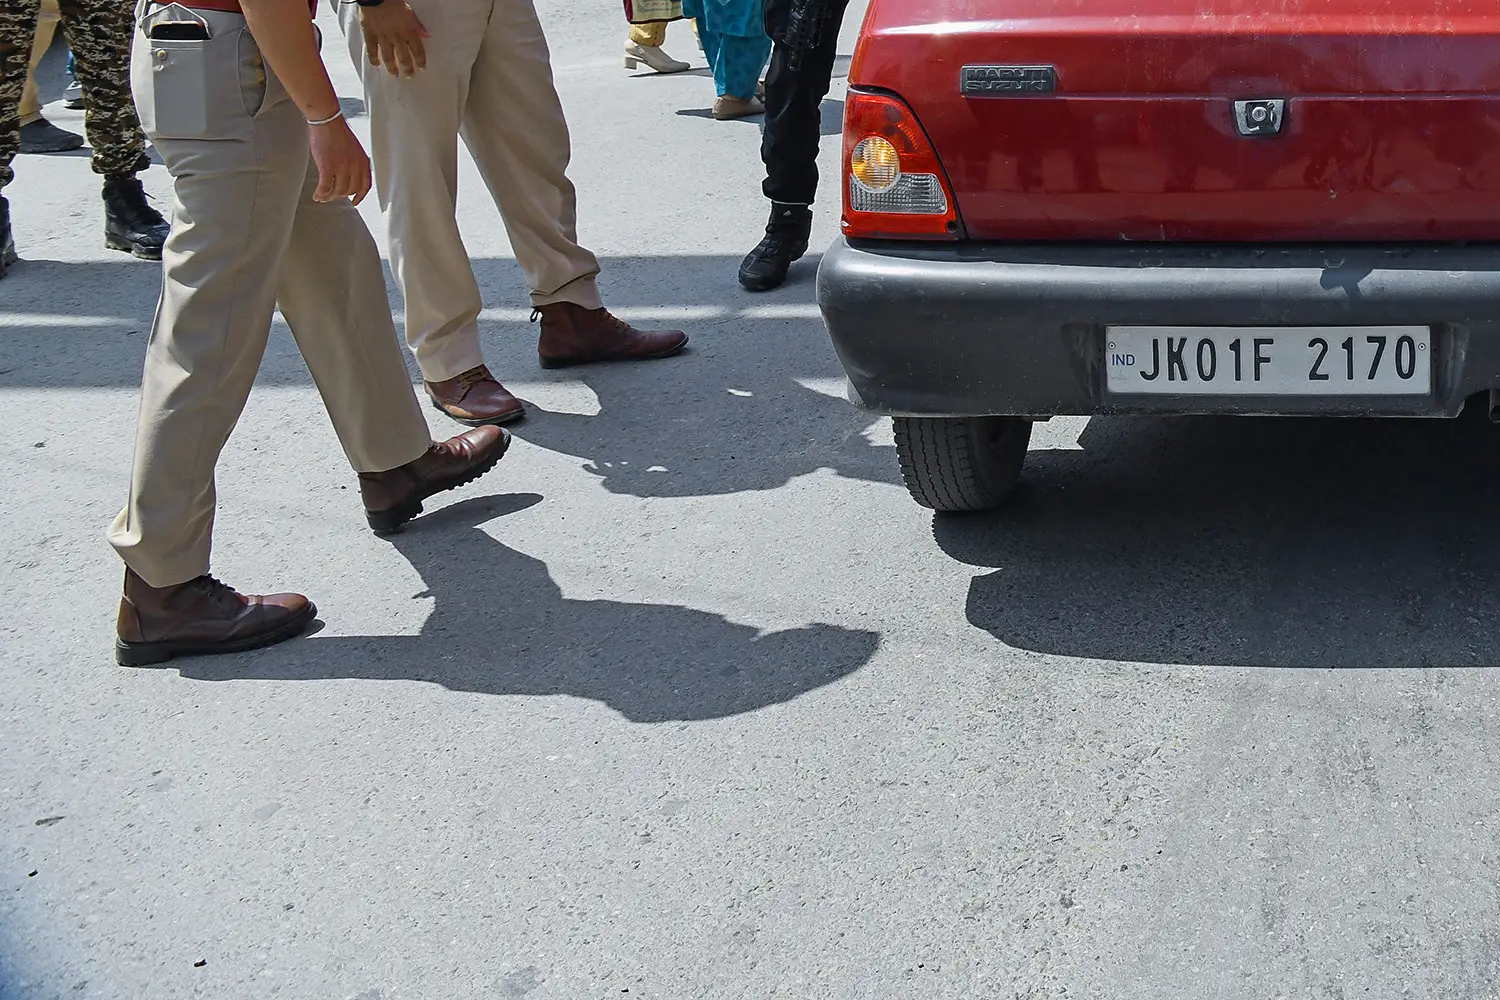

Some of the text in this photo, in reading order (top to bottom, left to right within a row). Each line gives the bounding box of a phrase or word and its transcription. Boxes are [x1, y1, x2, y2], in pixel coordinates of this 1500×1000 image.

[966, 68, 1051, 80] MARUTI
[966, 80, 1051, 93] SUZUKI
[1111, 353, 1136, 367] IND
[1138, 335, 1417, 383] JK01F 2170
